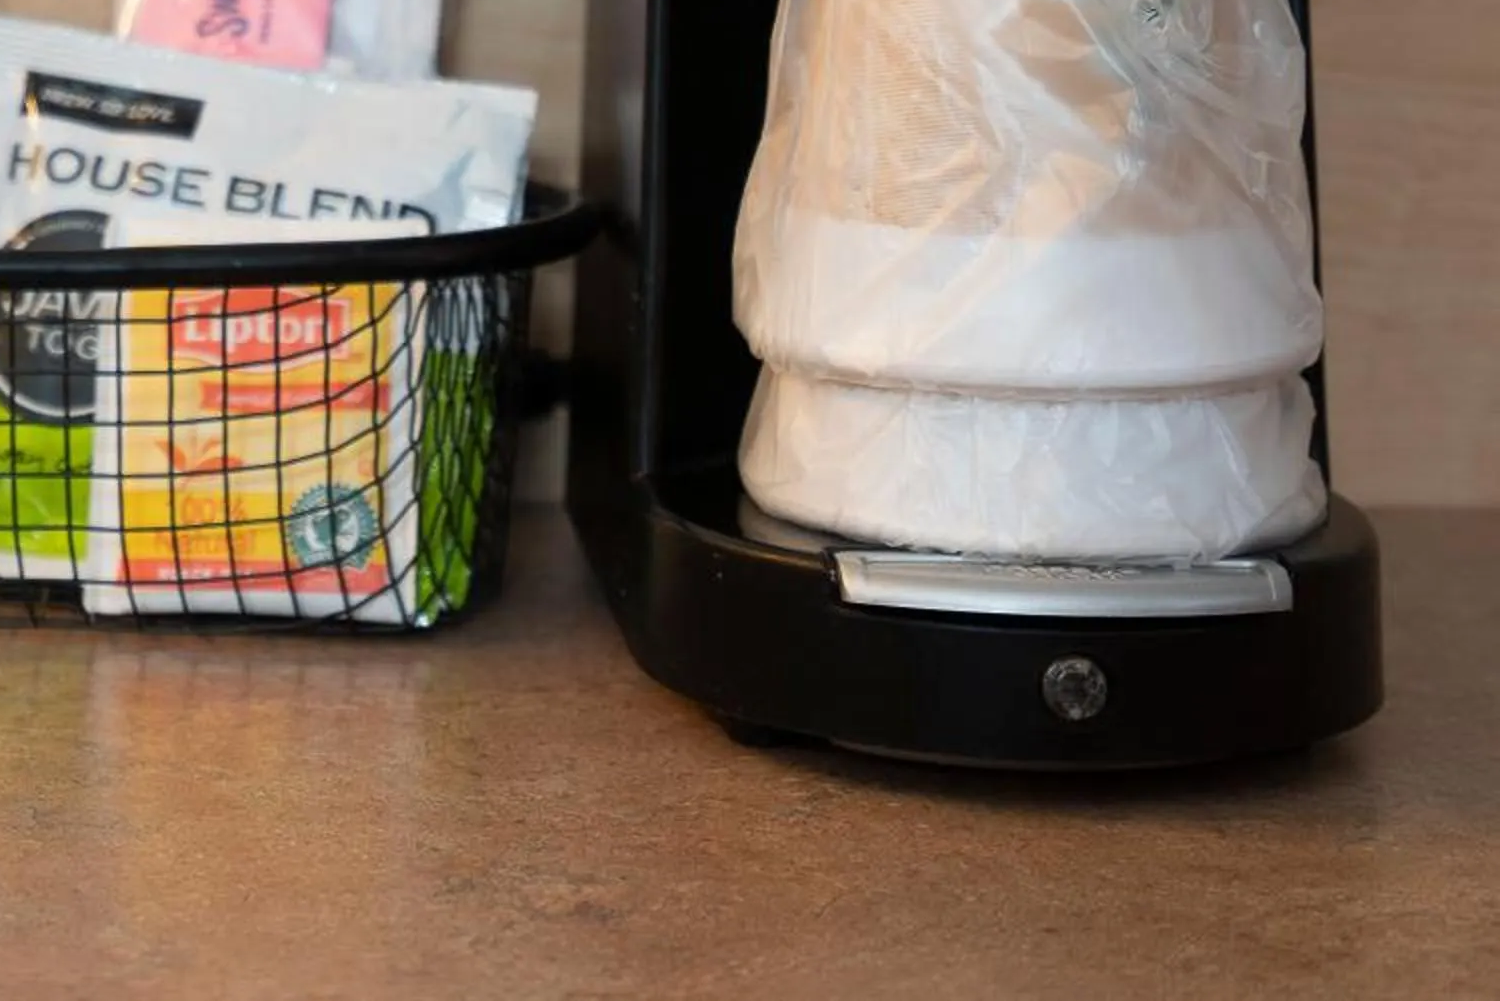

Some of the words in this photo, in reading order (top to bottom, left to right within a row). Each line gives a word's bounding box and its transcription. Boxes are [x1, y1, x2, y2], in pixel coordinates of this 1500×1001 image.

[8, 142, 211, 210] HOUSE
[2, 291, 99, 320] JAV
[183, 301, 334, 353] Lipton
